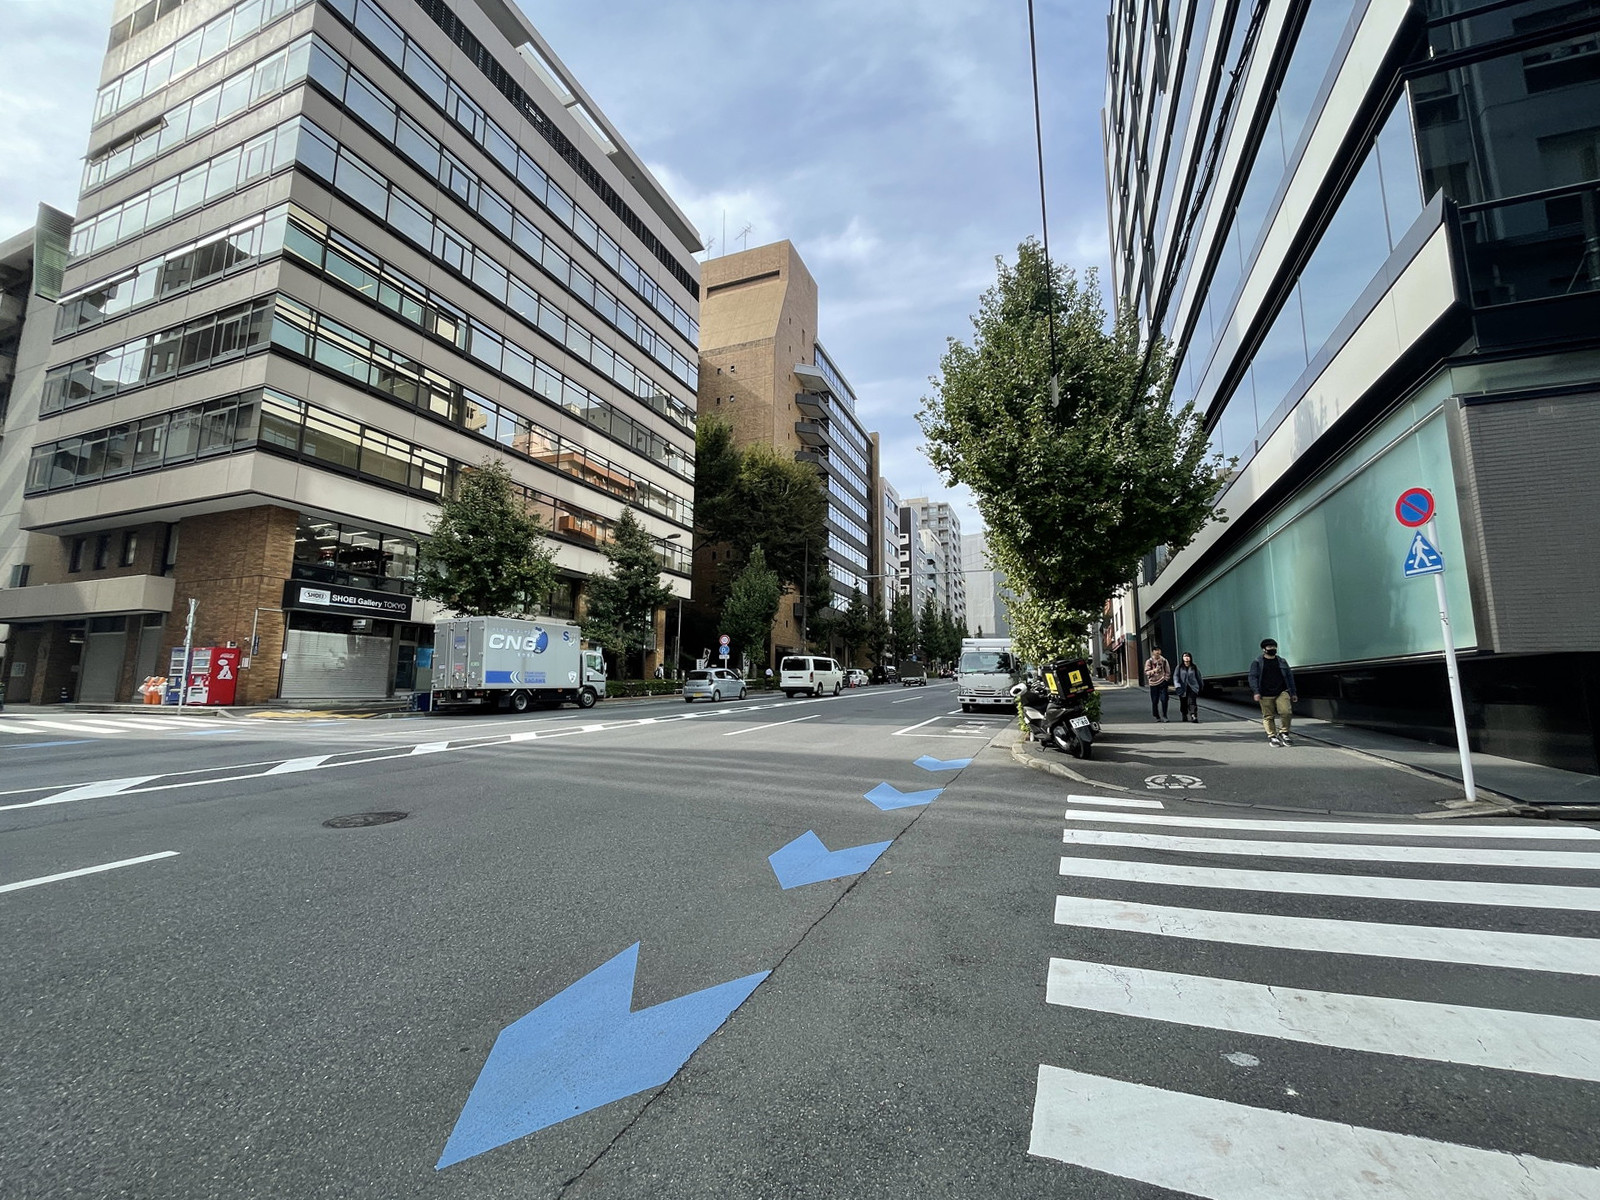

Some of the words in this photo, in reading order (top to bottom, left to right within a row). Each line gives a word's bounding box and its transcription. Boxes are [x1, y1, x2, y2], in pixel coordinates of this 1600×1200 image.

[332, 594, 356, 604] SHOEI
[357, 598, 383, 608] Gallery
[384, 601, 407, 610] TOKYO
[488, 634, 537, 651] CNG
